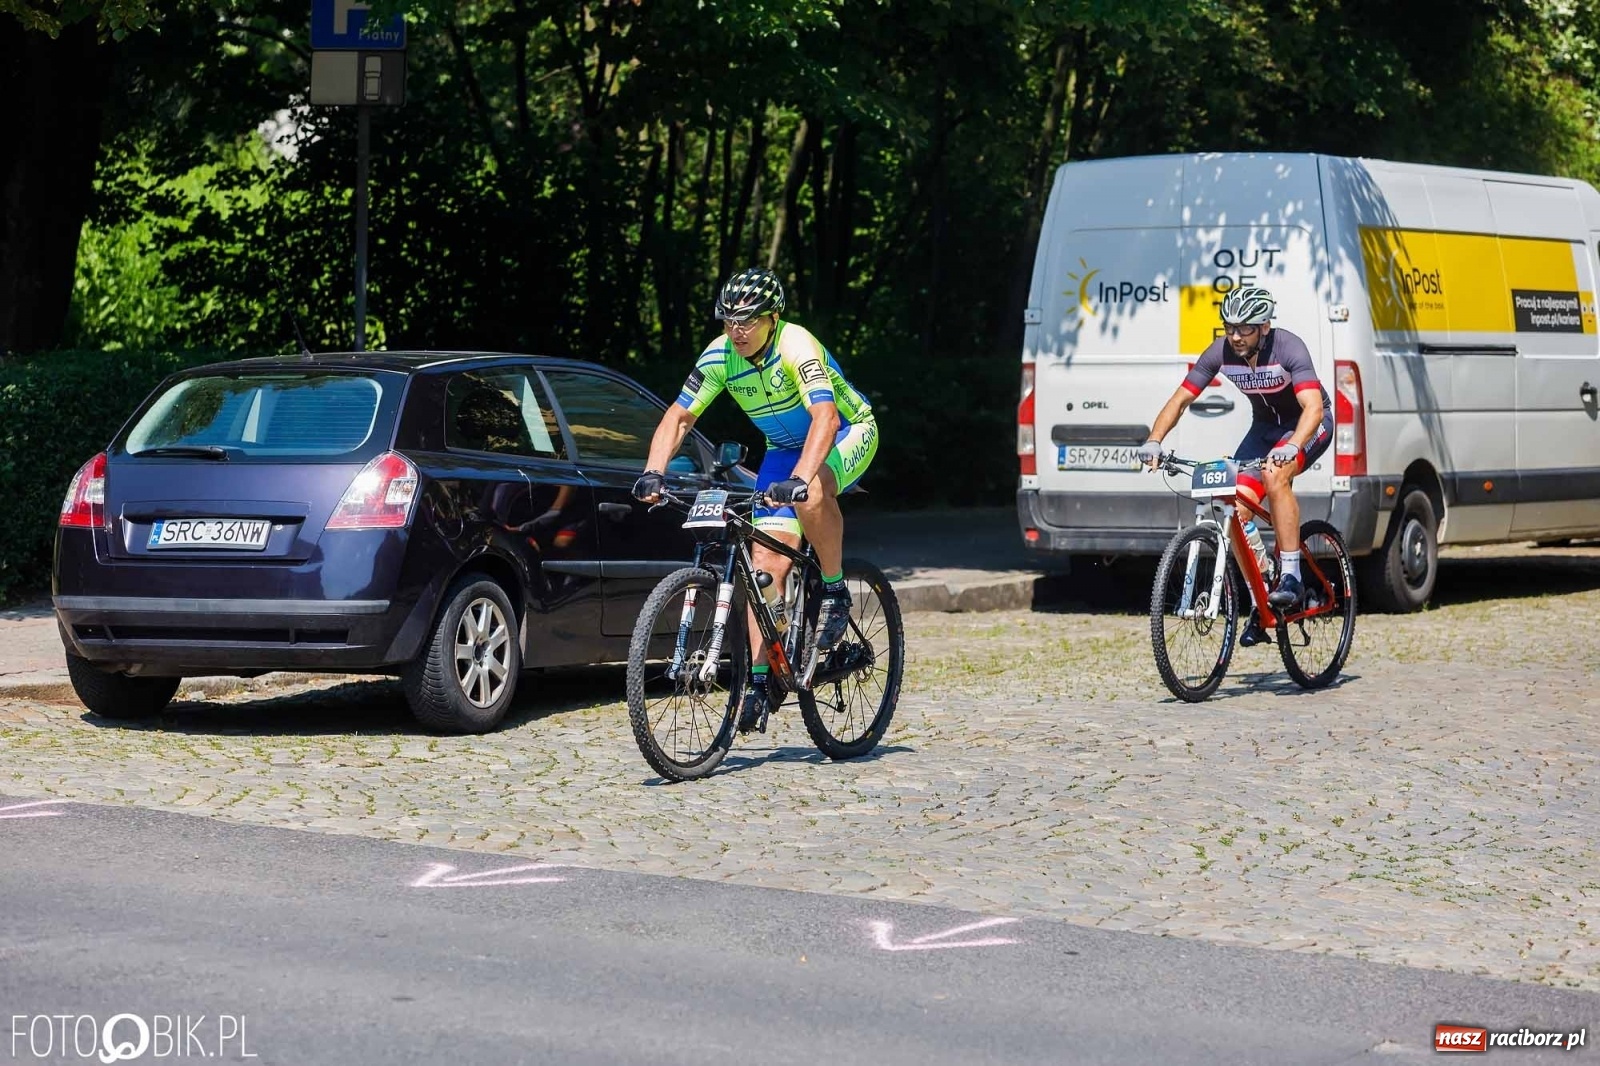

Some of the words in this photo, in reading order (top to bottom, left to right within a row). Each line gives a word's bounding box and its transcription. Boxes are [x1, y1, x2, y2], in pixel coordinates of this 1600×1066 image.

[1213, 249, 1281, 268] OUT
[1399, 267, 1442, 295] InPost
[1099, 281, 1169, 303] InPost
[727, 382, 758, 397] Energo
[1236, 376, 1284, 389] OWEROWE
[1082, 401, 1109, 409] OPEL
[1069, 448, 1087, 464] SR
[1092, 448, 1139, 464] 7946M
[1201, 471, 1227, 485] 1691
[691, 503, 723, 517] 1258
[163, 521, 207, 542] SRC
[210, 521, 266, 543] 36NW
